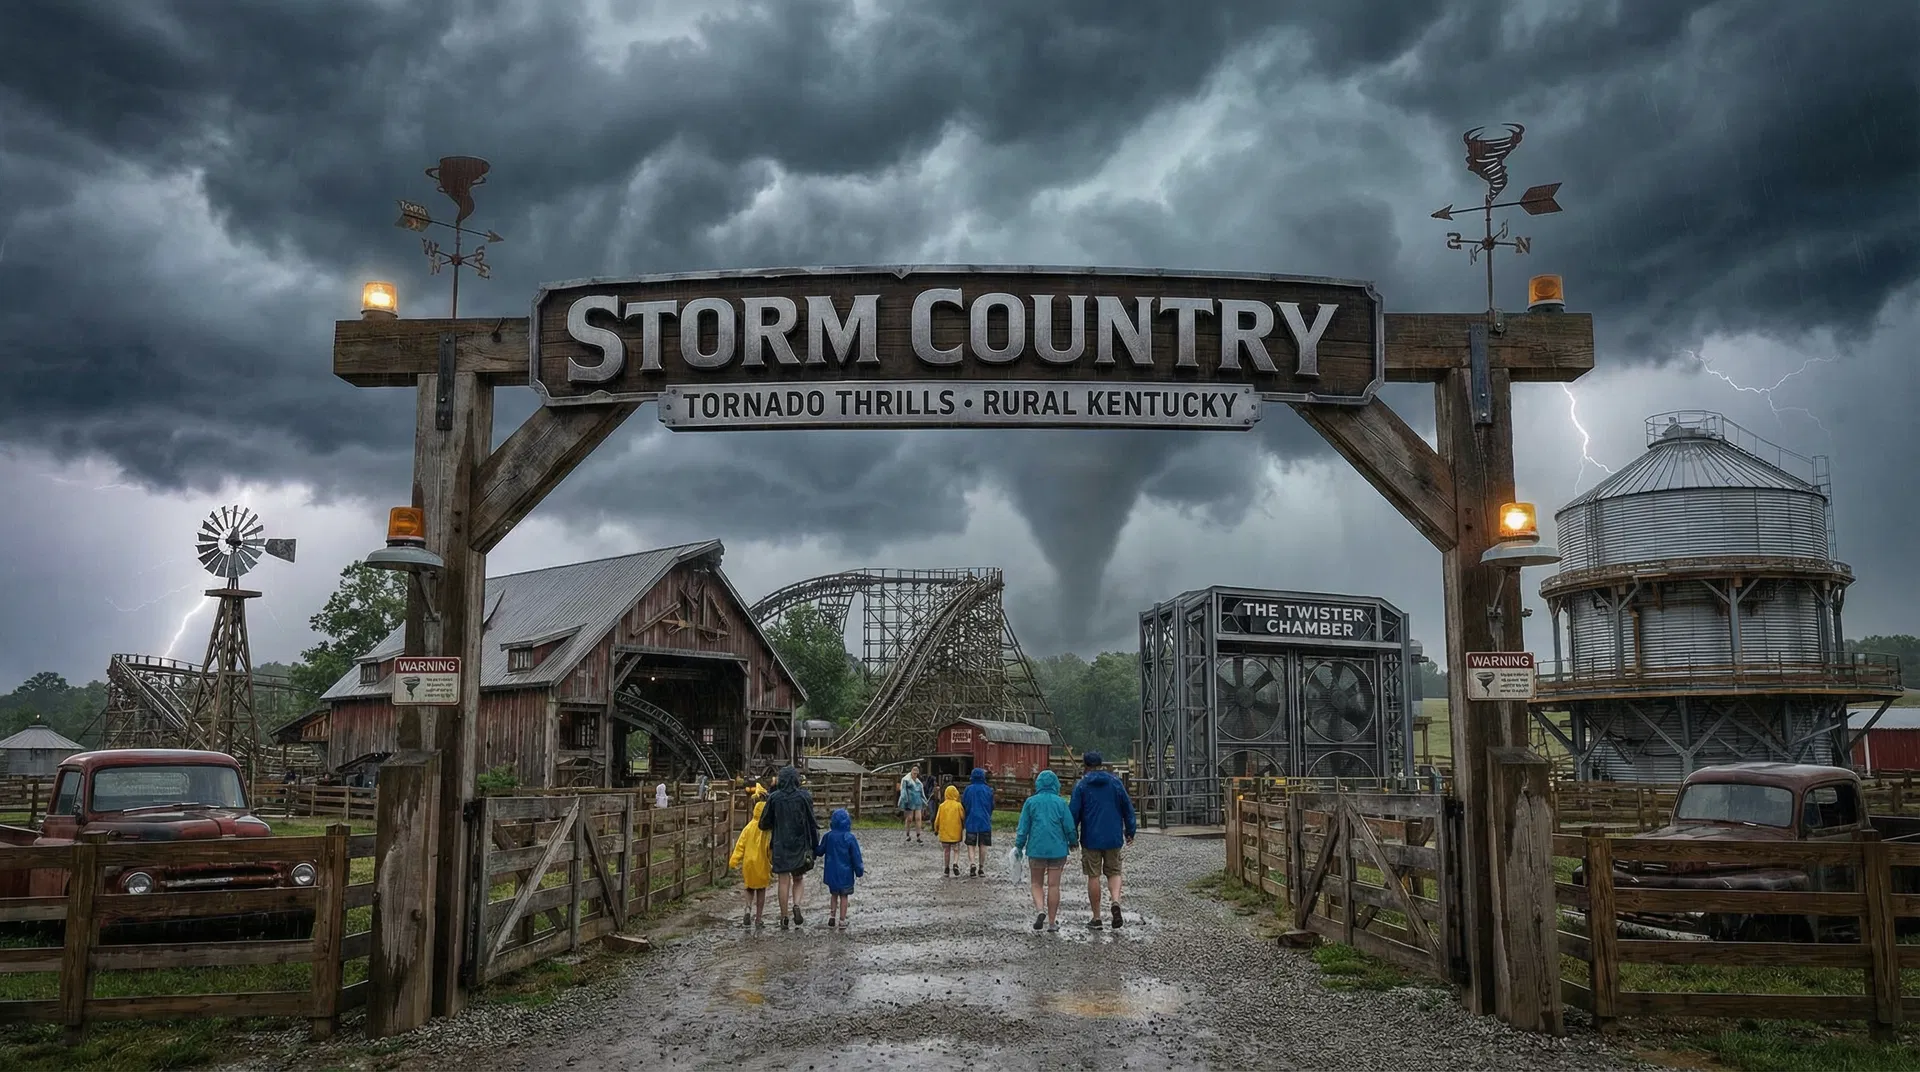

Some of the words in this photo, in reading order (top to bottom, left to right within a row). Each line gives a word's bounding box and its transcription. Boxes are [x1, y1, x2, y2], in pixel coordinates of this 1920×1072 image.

[567, 293, 881, 384] STORM
[911, 287, 1340, 378] COUNTRY
[683, 391, 826, 419] TORNADO
[835, 389, 955, 416] THRILLS
[983, 389, 1077, 415] RURAL
[1087, 391, 1239, 419] KENTUCKY
[1242, 602, 1279, 618] THE
[1284, 605, 1365, 622] TWISTER
[1266, 619, 1354, 637] CHAMBER
[399, 661, 456, 672] WARNING
[1472, 656, 1530, 667] WARNING
